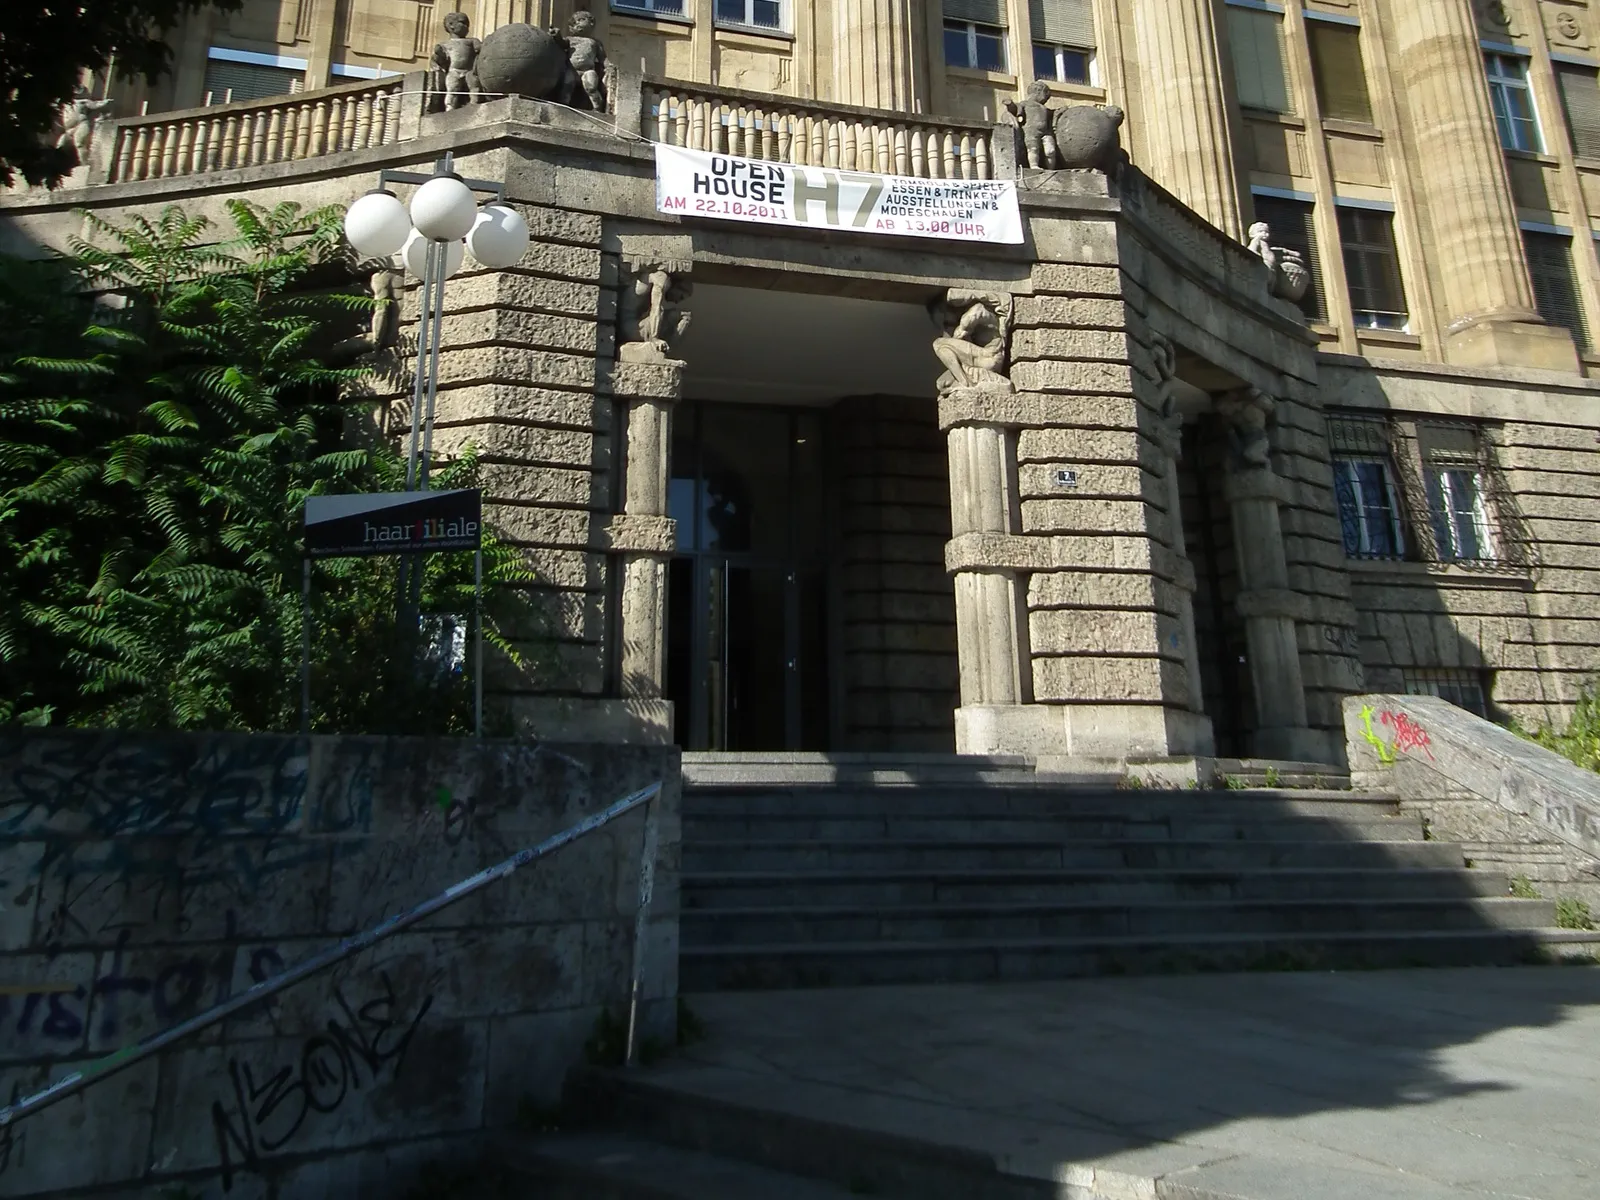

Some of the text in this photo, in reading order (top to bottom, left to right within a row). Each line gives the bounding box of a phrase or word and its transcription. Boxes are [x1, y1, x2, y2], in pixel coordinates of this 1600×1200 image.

[711, 157, 785, 182] OPEN
[693, 172, 785, 205] HOUSE
[792, 168, 884, 228] H7
[892, 185, 998, 200] ESSEN & TRINKEN
[664, 196, 789, 220] AM 22.10.2011
[881, 205, 973, 219] MODESCHAUEN
[886, 194, 999, 210] AUSSTELLUNGEN &
[876, 219, 986, 236] AB 13.00 UHR
